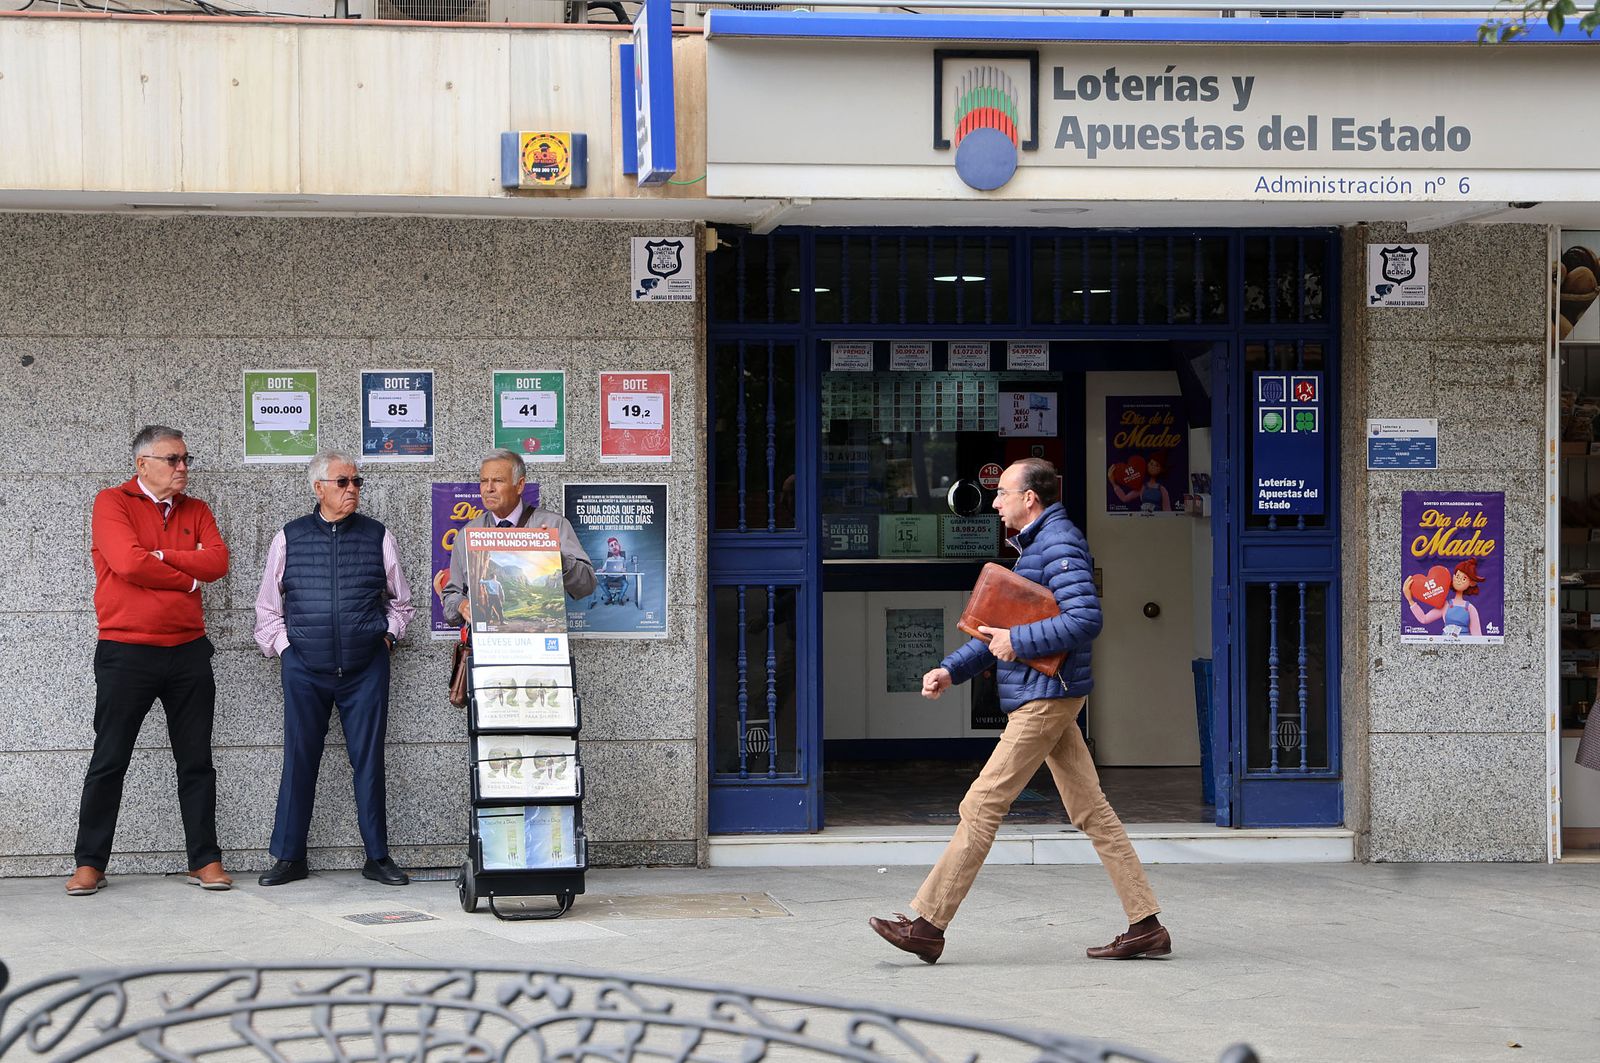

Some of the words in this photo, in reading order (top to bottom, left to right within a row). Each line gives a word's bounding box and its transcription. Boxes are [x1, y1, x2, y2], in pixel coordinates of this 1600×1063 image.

[1053, 65, 1219, 102] Loterías
[1232, 76, 1255, 111] y
[1054, 116, 1245, 159] Apuestas
[1257, 115, 1317, 151] del
[1331, 116, 1471, 151] Estado
[1254, 175, 1411, 193] Administración
[1459, 177, 1470, 194] 6
[268, 378, 293, 389] BOTE
[385, 378, 410, 389] BOTE
[516, 378, 542, 389] BOTE
[623, 379, 648, 390] BOTE
[260, 406, 302, 414] 900.000
[388, 404, 408, 416] 85
[519, 404, 537, 416] 41
[622, 405, 651, 418] 19,2
[1113, 424, 1181, 449] Madre
[1259, 478, 1296, 487] Loterías
[1299, 480, 1304, 488] y
[1259, 490, 1301, 500] Apuestas
[1303, 489, 1318, 498] del
[576, 505, 586, 515] ES
[587, 505, 601, 515] UNA
[602, 505, 620, 515] COSA
[621, 505, 636, 515] QUE
[637, 505, 655, 515] PASA
[1259, 500, 1291, 509] Estado
[620, 515, 635, 524] LOS
[1454, 511, 1472, 527] de
[1472, 511, 1488, 528] la
[469, 531, 504, 539] PRONTO
[504, 532, 549, 540] VIVIREMOS
[1411, 527, 1495, 557] Madre
[1424, 579, 1437, 590] 15
[1486, 622, 1493, 631] 4
[477, 636, 512, 647] LLÉVESE
[514, 638, 532, 647] UNA
